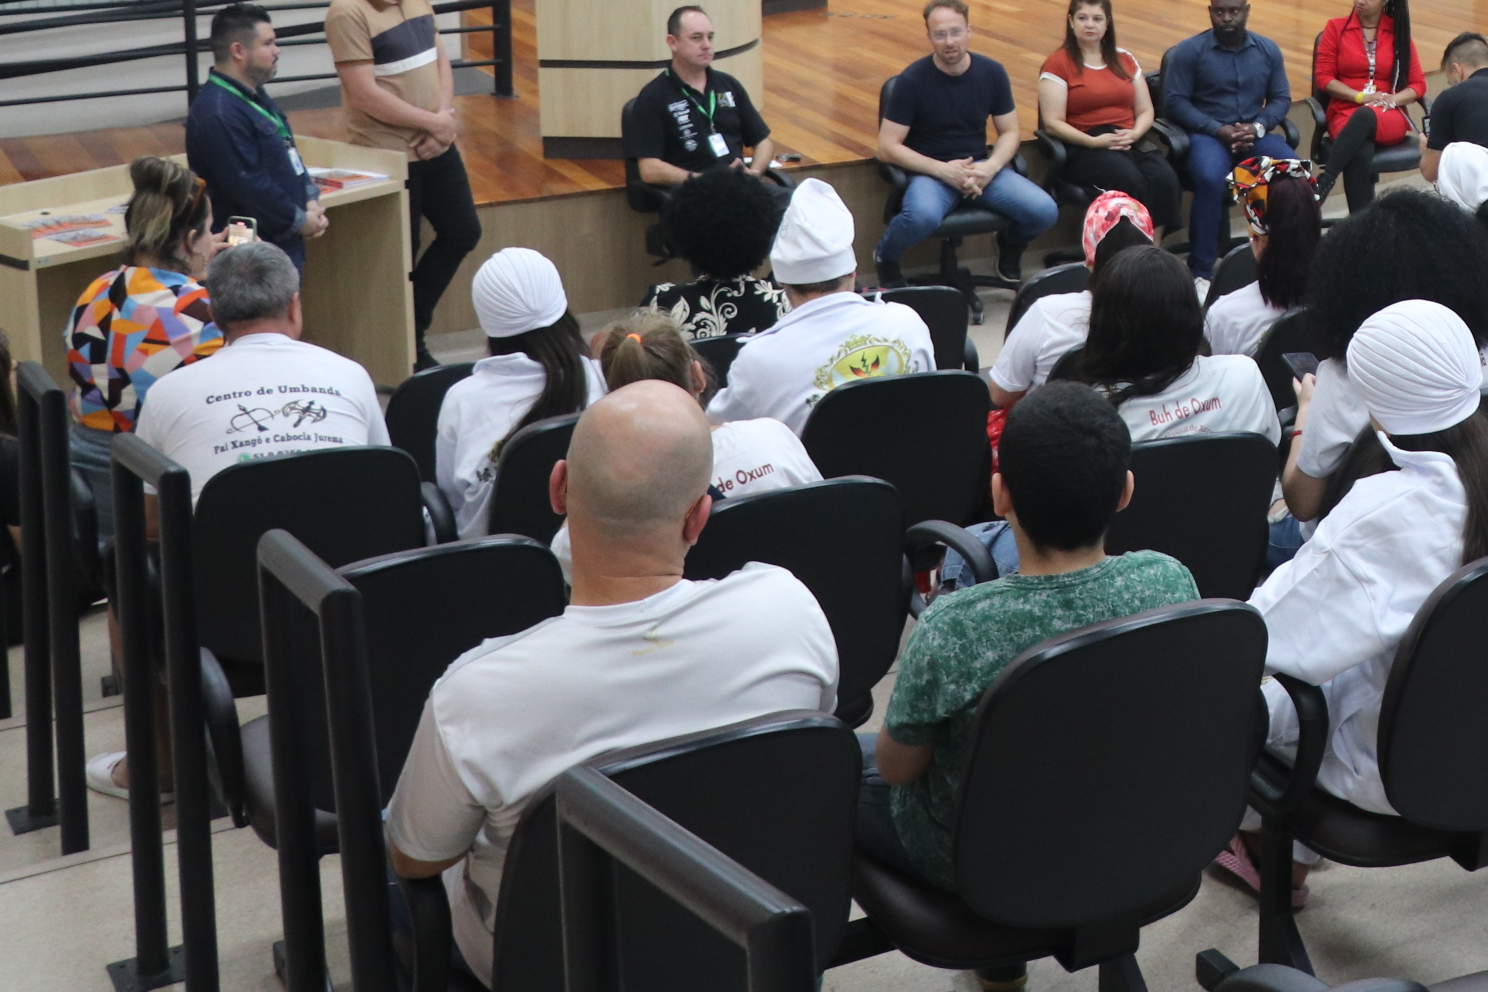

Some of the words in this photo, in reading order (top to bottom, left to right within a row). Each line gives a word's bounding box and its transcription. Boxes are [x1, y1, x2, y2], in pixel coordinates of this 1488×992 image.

[206, 389, 252, 404] Centro
[256, 386, 274, 395] de
[278, 384, 341, 396] Umbanda
[1149, 404, 1173, 426] Buh
[1174, 400, 1190, 420] de
[1190, 397, 1221, 415] Oxum
[214, 442, 229, 454] Pai
[273, 432, 311, 444] Cabocla
[315, 432, 344, 444] Jurema
[717, 476, 734, 493] de
[736, 463, 774, 485] Oxum
